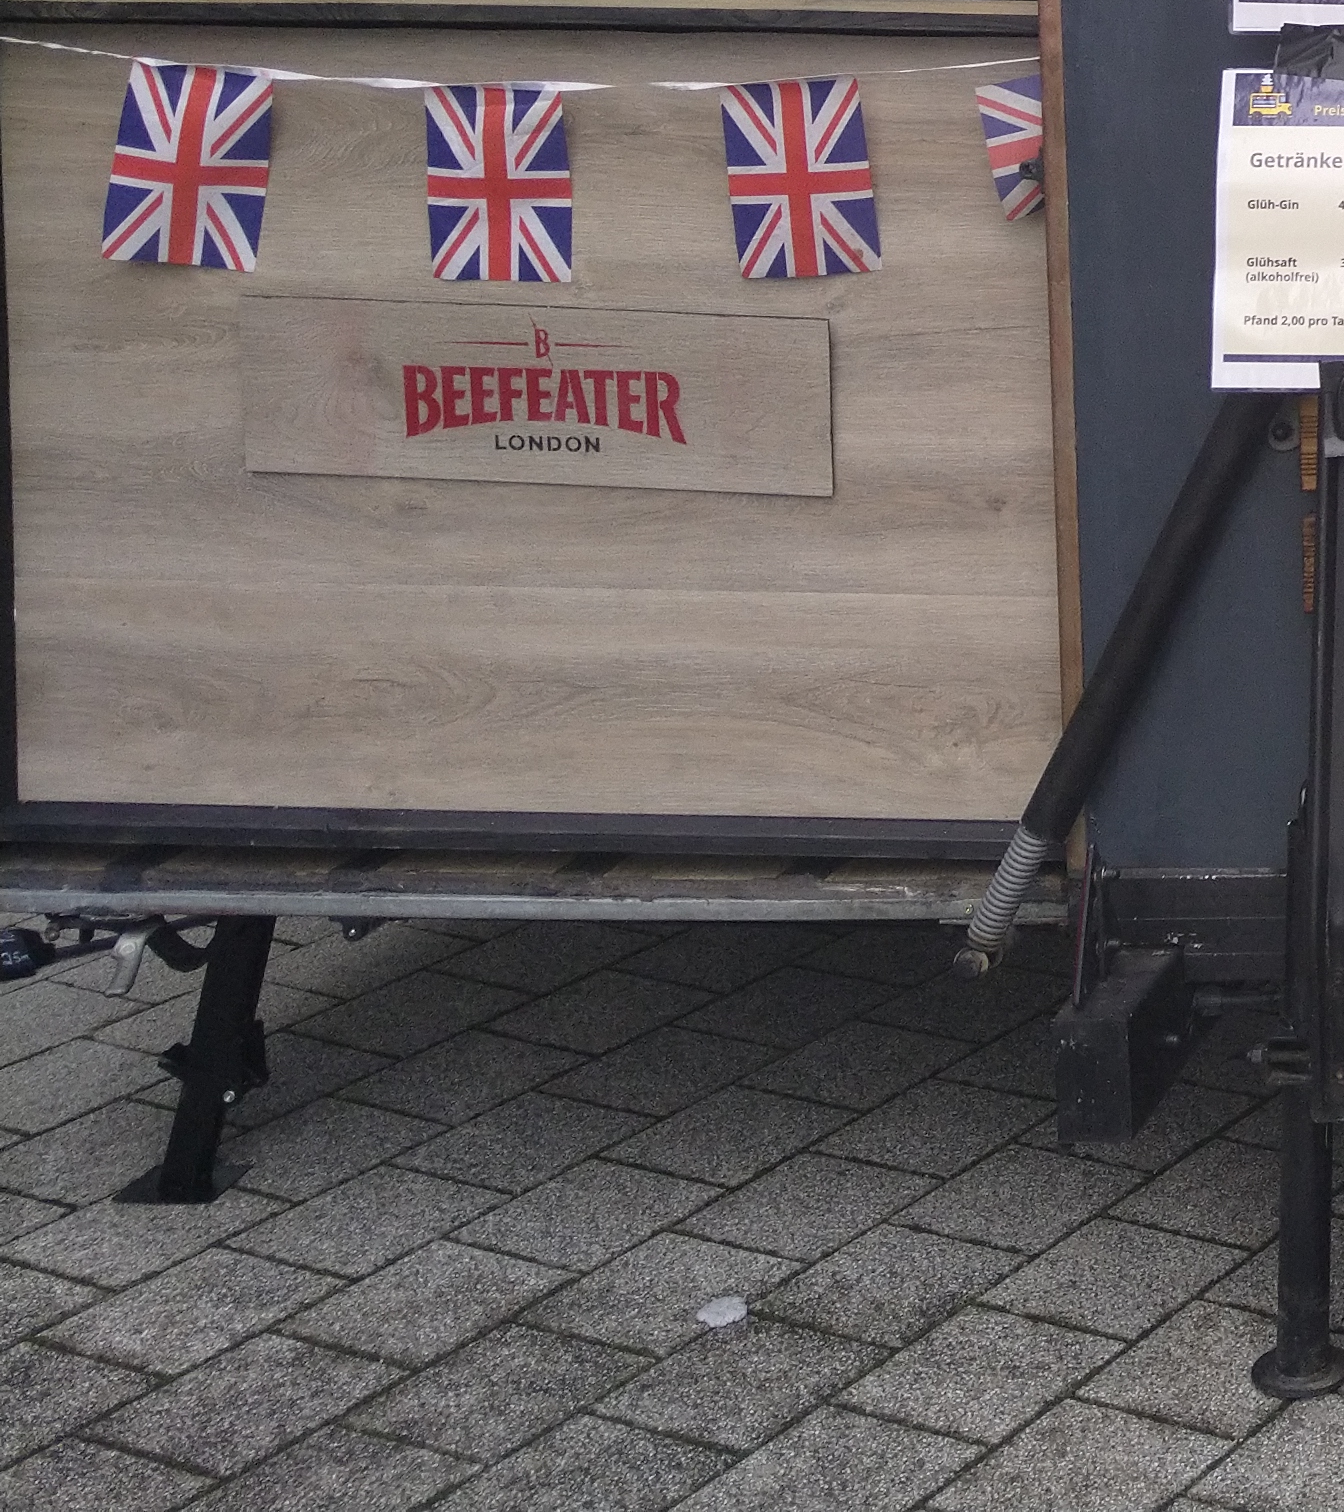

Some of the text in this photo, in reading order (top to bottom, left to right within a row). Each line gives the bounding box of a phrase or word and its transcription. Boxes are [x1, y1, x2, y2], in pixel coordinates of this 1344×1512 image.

[1249, 151, 1343, 170] Getränke
[1247, 198, 1300, 211] Glüh-Gin
[1246, 256, 1298, 269] Glühsaft
[1245, 271, 1320, 284] (alkoholfrei)
[1243, 314, 1278, 327] Pfand
[1281, 315, 1306, 328] 2,00
[1308, 316, 1328, 330] pro
[402, 363, 688, 446] BEEFEATER
[494, 433, 602, 454] LONDON
